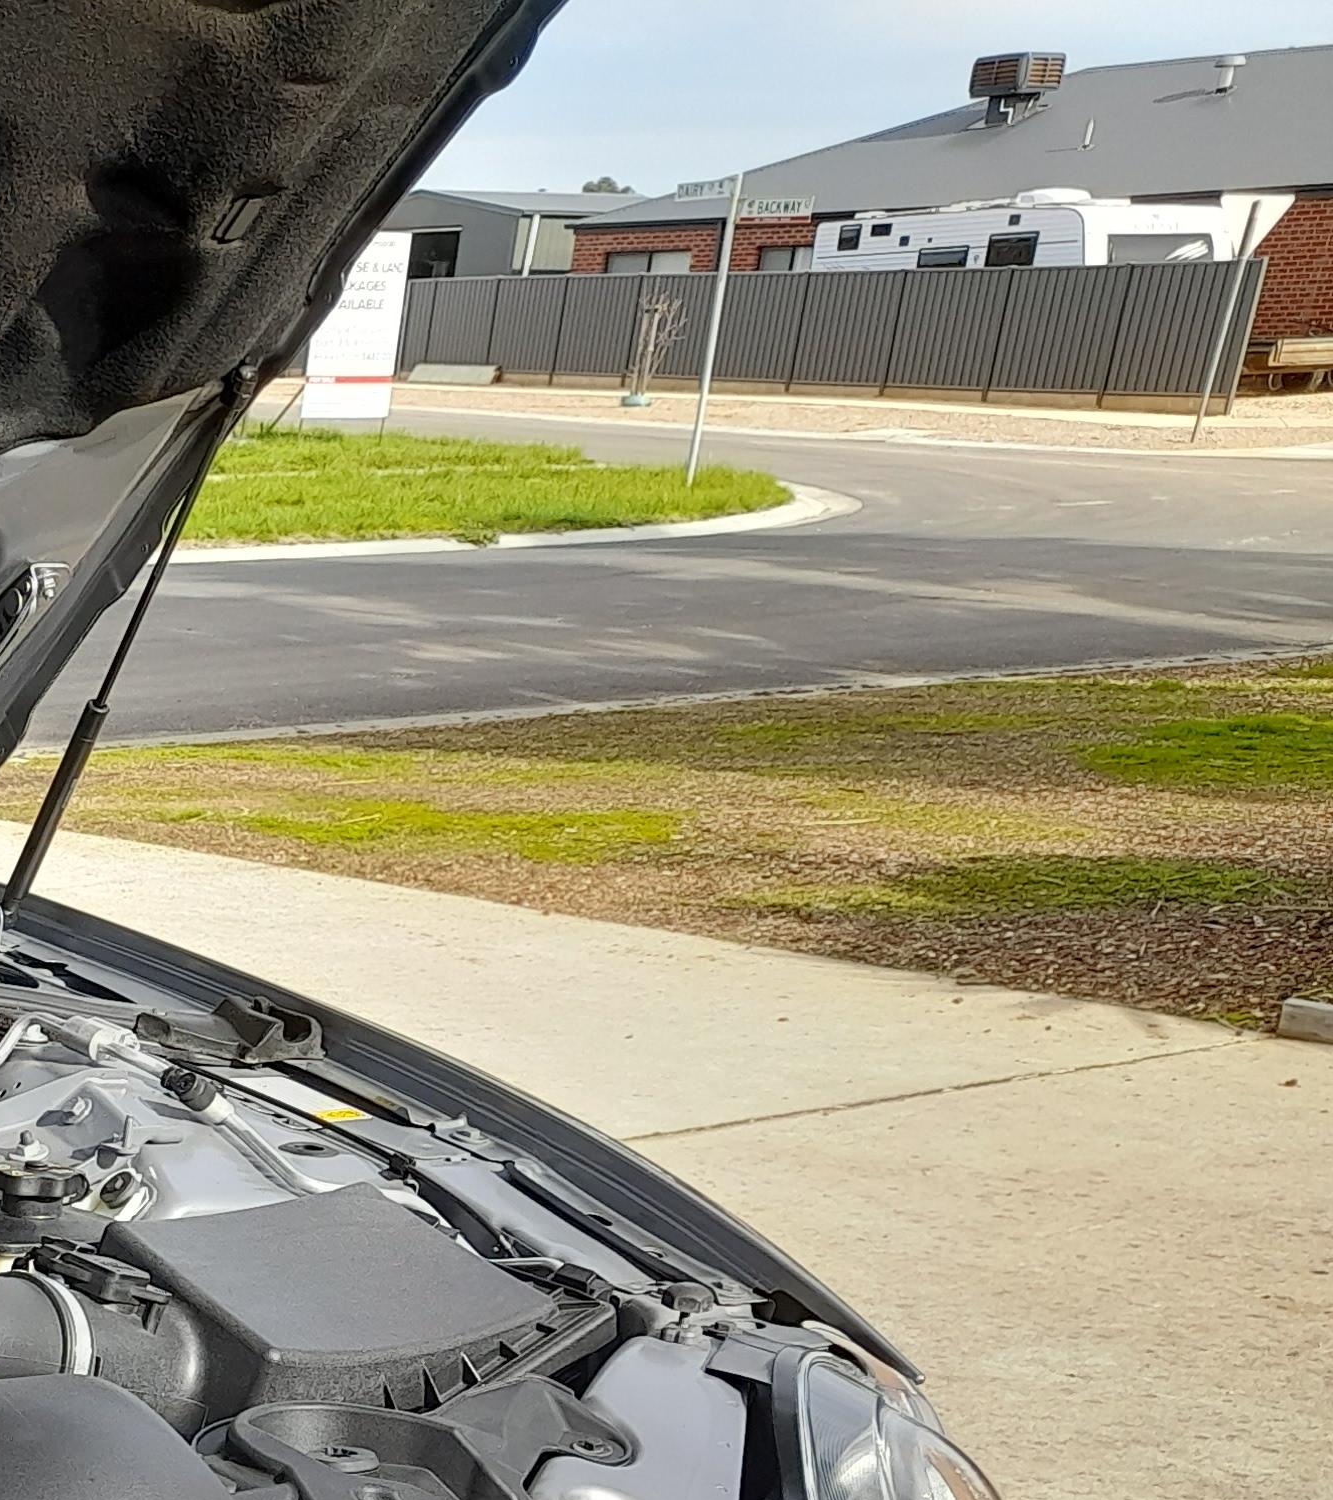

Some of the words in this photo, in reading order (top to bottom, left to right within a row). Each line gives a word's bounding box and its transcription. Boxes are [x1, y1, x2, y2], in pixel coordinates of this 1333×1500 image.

[677, 183, 704, 199] DAIRY
[757, 200, 801, 215] BACKWAY
[344, 280, 386, 291] KAGES
[338, 299, 384, 310] AILABLE
